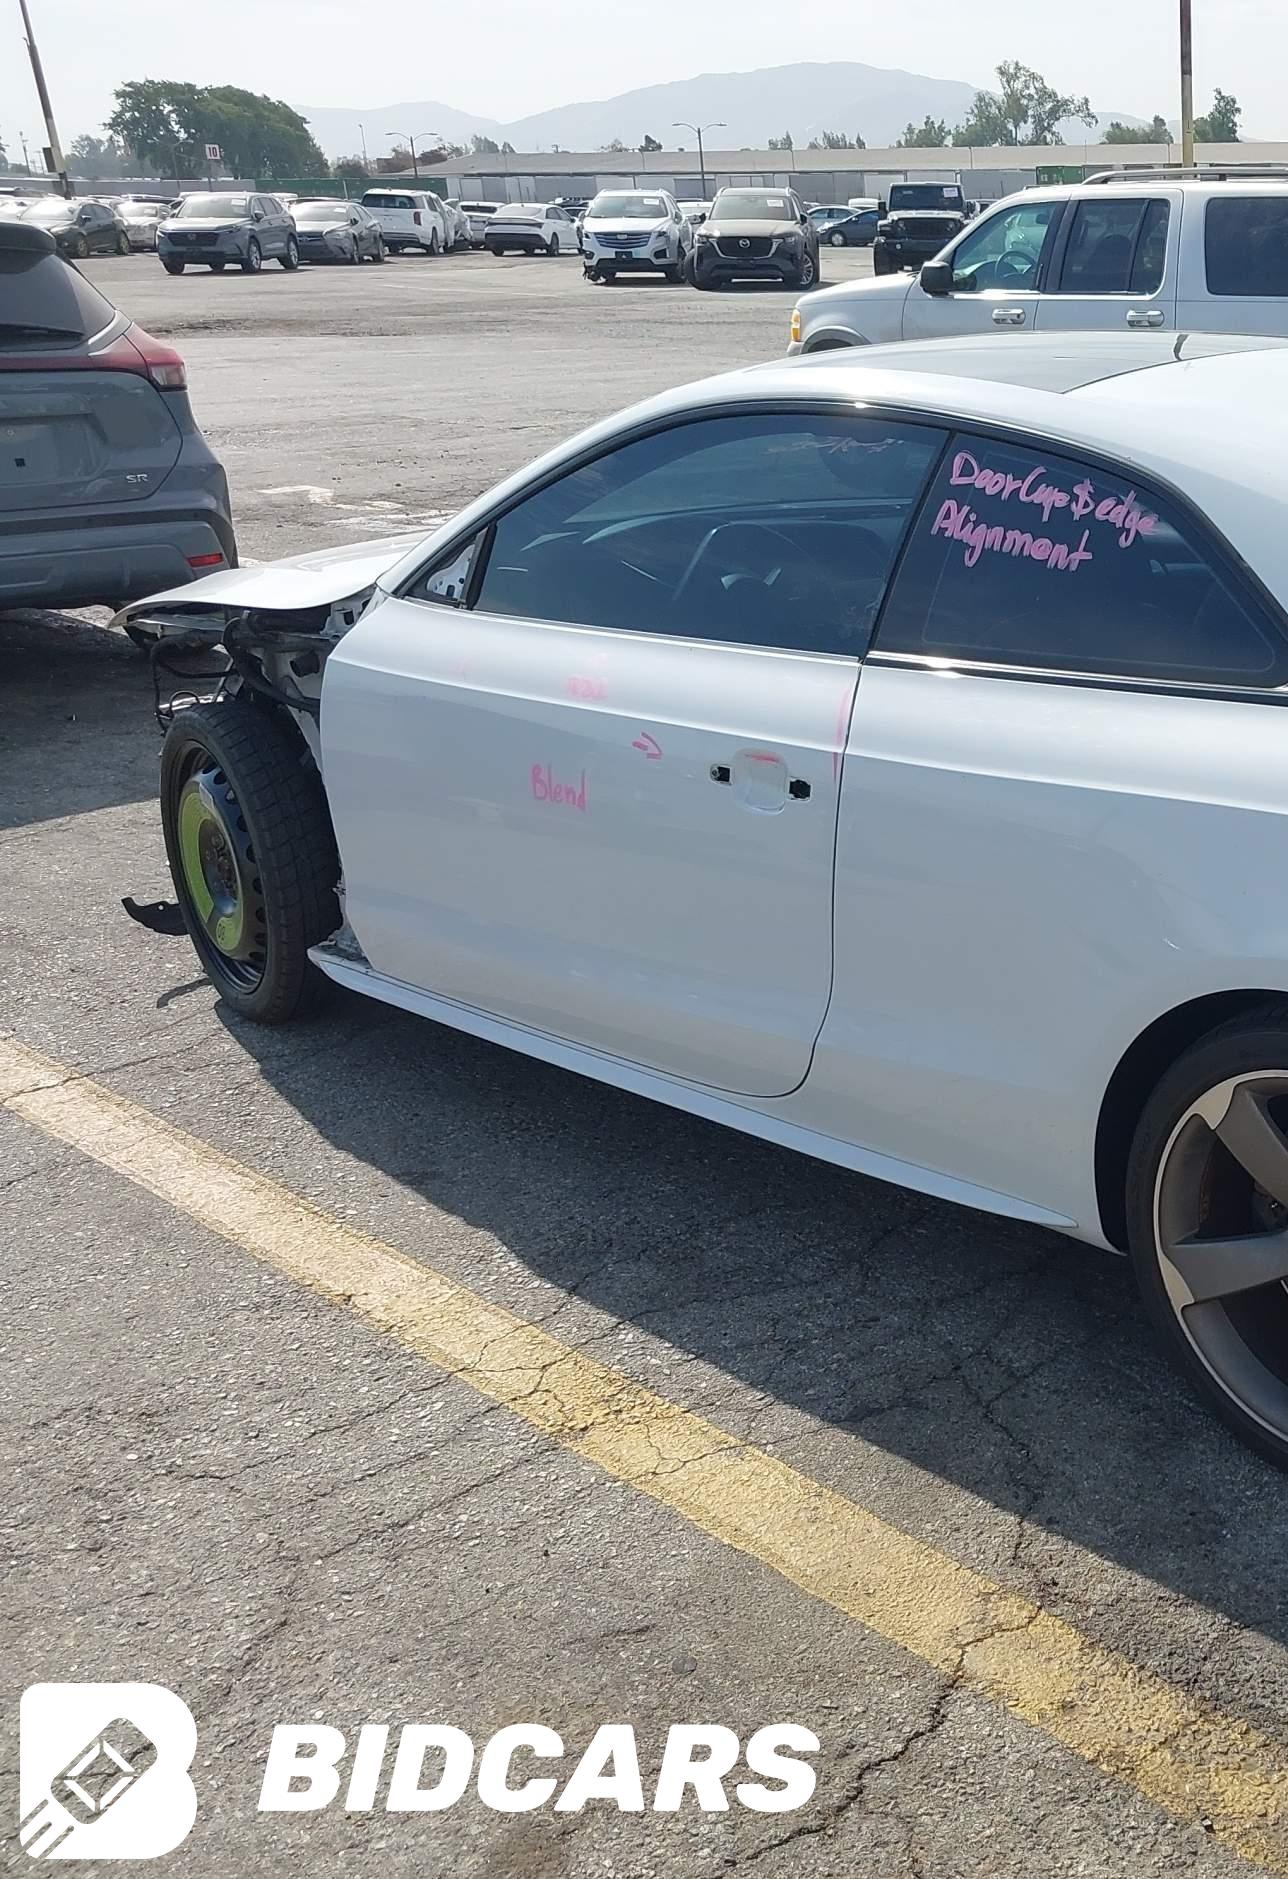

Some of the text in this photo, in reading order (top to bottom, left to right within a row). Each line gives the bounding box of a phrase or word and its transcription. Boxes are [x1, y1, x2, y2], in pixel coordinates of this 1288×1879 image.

[208, 146, 218, 158] 10
[126, 473, 148, 483] SR
[931, 499, 1093, 571] Alignment
[531, 763, 587, 812] Blend
